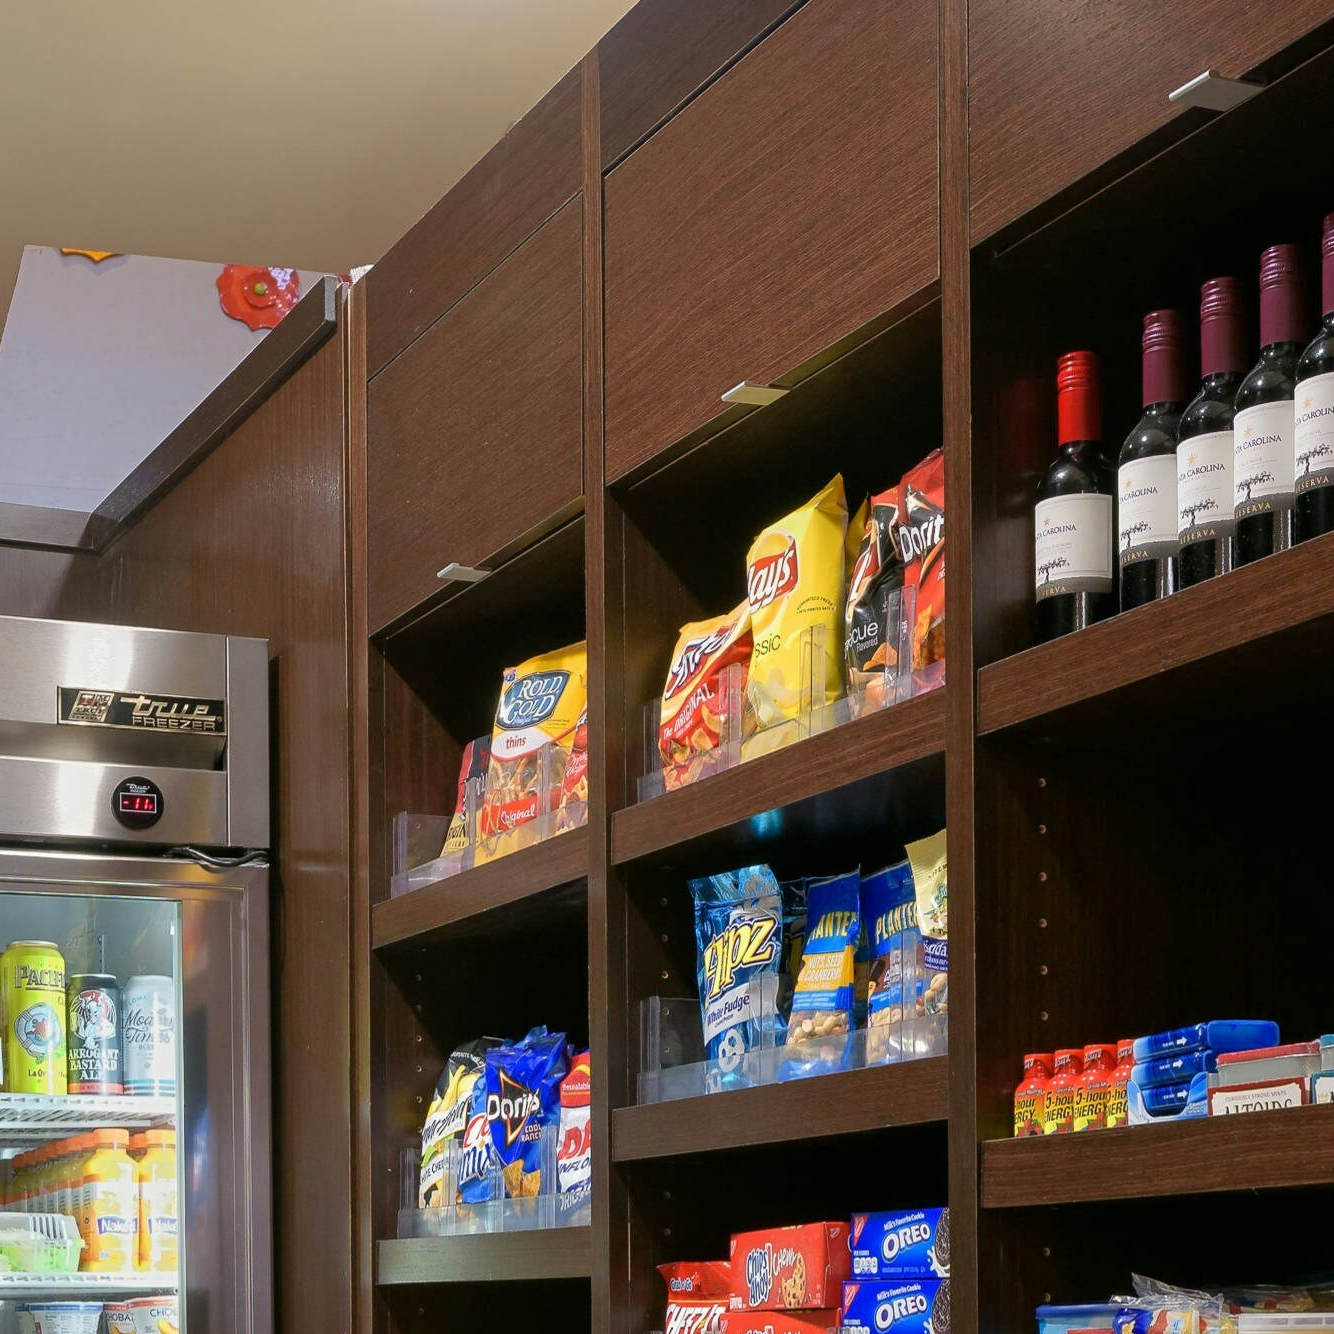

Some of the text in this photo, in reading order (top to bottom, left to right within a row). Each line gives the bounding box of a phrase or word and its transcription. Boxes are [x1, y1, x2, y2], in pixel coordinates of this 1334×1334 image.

[1242, 434, 1282, 451] CAROLINA
[1186, 463, 1226, 478] CAROLINA
[899, 515, 945, 563] Dorit
[856, 636, 879, 653] Flavored
[518, 675, 564, 700] ROLD
[505, 695, 555, 724] GOLD
[673, 682, 715, 733] ORIGINAL
[132, 716, 216, 732] FREEZER
[505, 735, 527, 749] thins
[500, 805, 536, 825] Original
[875, 900, 919, 945] PLANTE
[723, 994, 750, 1016] Fudge
[68, 1048, 120, 1060] ARROGANT
[70, 1059, 118, 1071] BASTARD
[79, 1070, 105, 1080] ALE
[1014, 1098, 1036, 1109] -hour
[1045, 1091, 1074, 1109] 5-hou
[1224, 1089, 1287, 1102] CURIOUSLY STRONG MINTS
[524, 1123, 542, 1134] COOL
[897, 1217, 911, 1228] Favorite
[910, 1213, 925, 1225] Cookie
[880, 1224, 931, 1260] OREO
[891, 1287, 907, 1297] Favorite
[907, 1284, 921, 1294] Cookie
[875, 1295, 928, 1331] OREO
